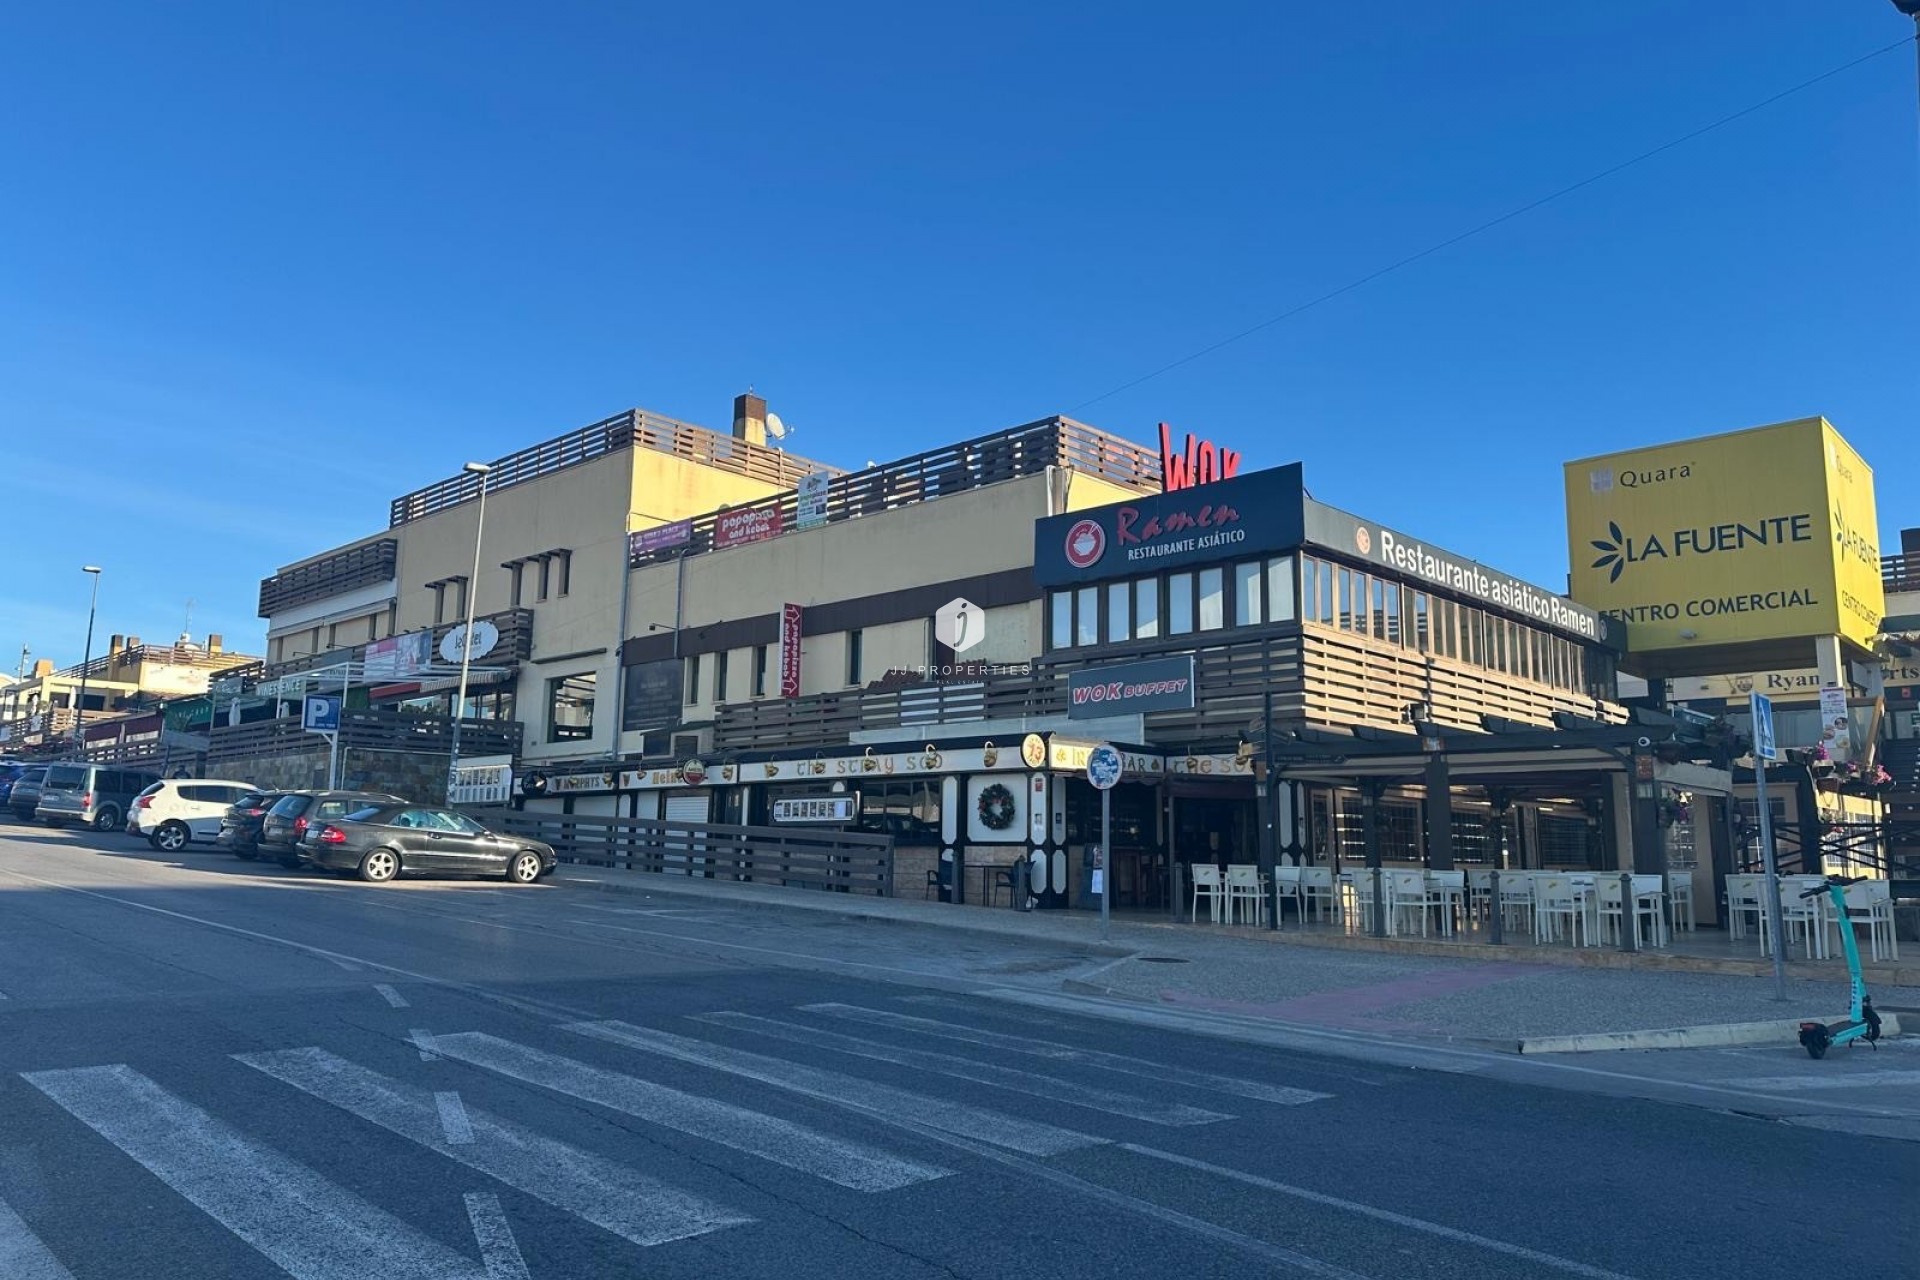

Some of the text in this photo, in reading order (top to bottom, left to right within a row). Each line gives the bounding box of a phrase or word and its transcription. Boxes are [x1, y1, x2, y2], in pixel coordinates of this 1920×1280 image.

[1620, 465, 1690, 488] Quara
[1117, 505, 1240, 545] Ramen
[1627, 514, 1811, 562] LA FUENTE
[1128, 530, 1245, 561] RESTAURANTE ASIÁTICO
[1381, 531, 1594, 636] Restaurante asiático Ramen
[1686, 589, 1818, 617] COMERCIAL
[1073, 679, 1188, 704] WOK BUFFET
[307, 699, 329, 726] P
